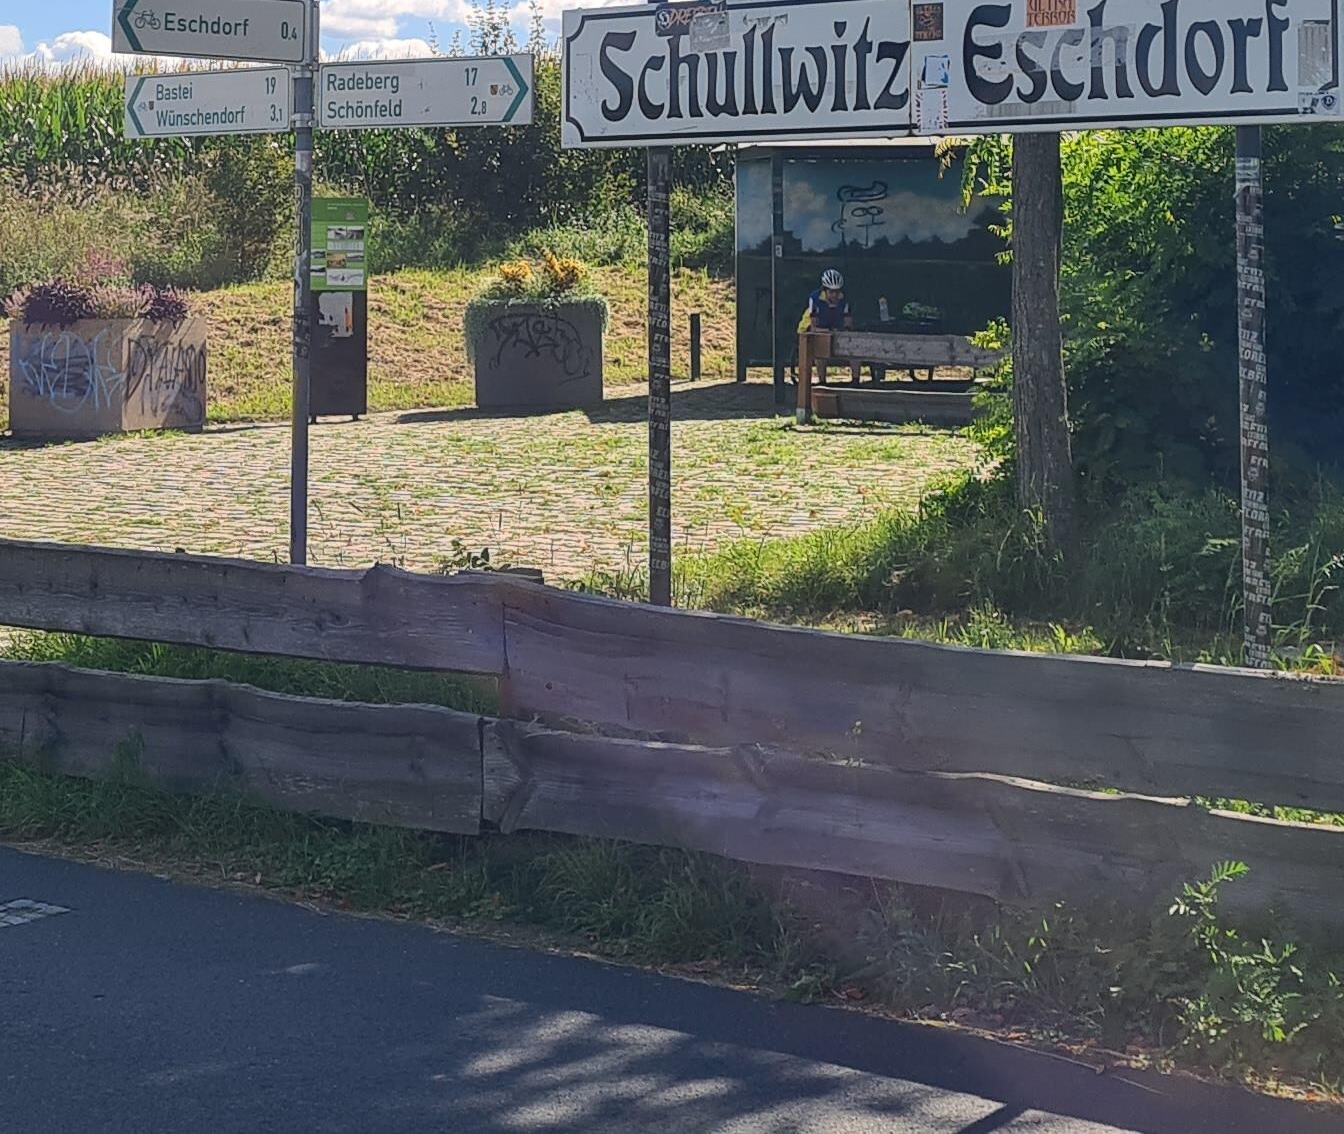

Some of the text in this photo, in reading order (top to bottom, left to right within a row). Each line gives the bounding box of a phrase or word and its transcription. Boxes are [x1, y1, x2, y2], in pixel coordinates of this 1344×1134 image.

[164, 12, 249, 36] Eschdorf
[1027, 10, 1076, 26] TERROR
[327, 67, 479, 93] Radeberg 17
[600, 16, 911, 122] Schullwitz
[156, 77, 277, 100] Bastei 19
[156, 104, 283, 127] Wünschendorf 3,1
[327, 96, 487, 119] Schönfeld 2,8
